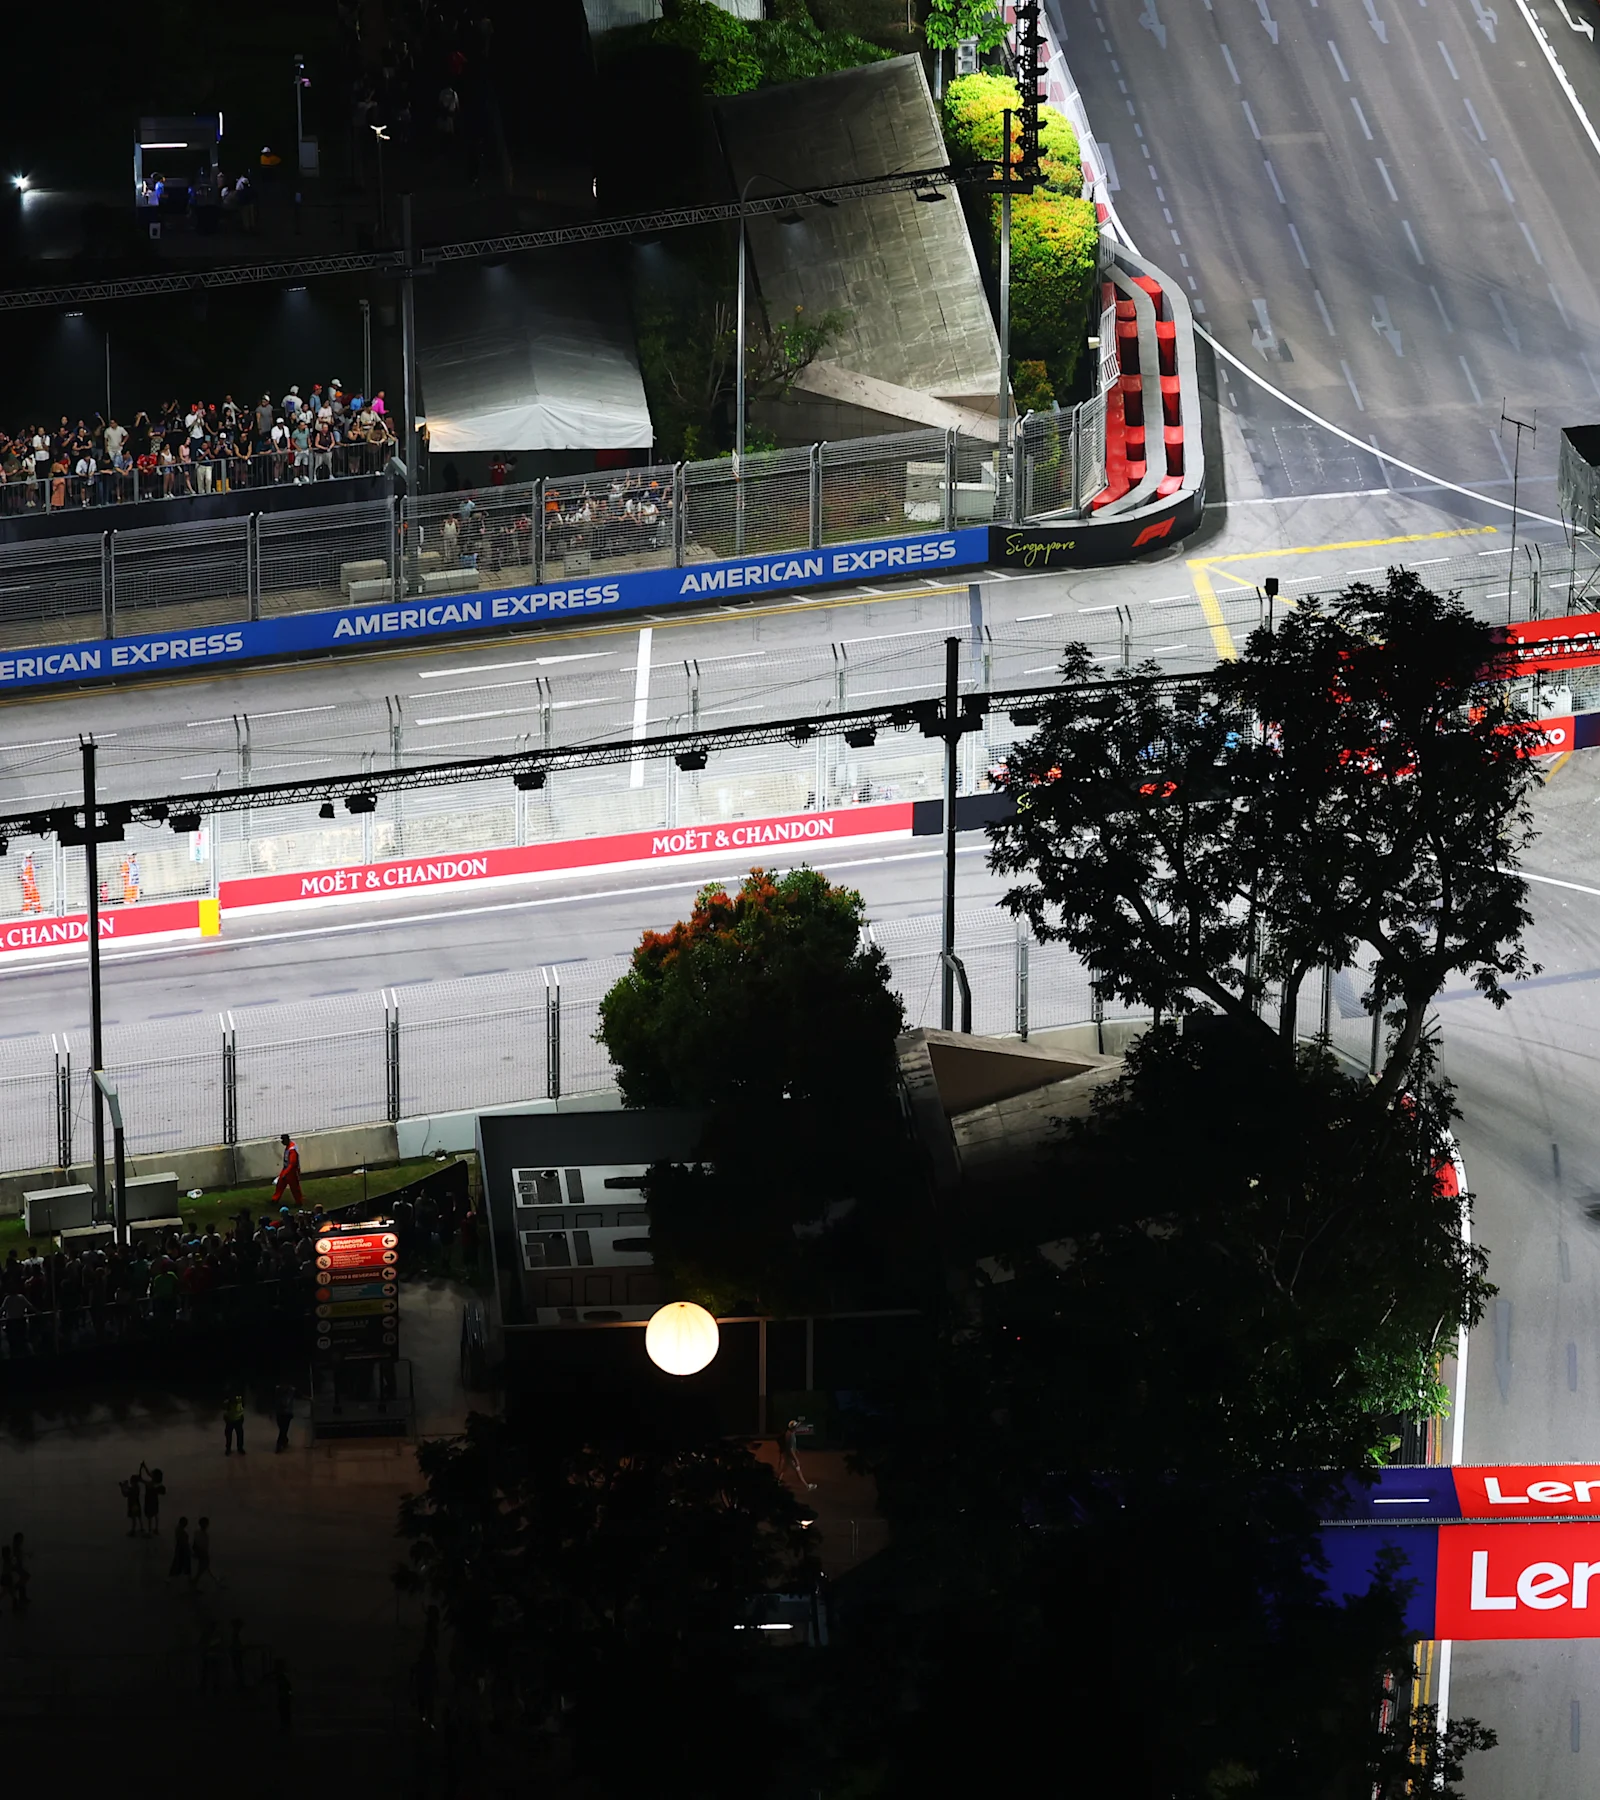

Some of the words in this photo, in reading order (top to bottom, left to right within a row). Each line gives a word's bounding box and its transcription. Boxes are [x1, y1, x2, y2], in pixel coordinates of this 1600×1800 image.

[680, 555, 823, 594] AMERICAN
[833, 540, 956, 571] EXPRESS
[1006, 533, 1077, 567] Singapore
[333, 601, 482, 639] AMERICAN
[492, 584, 620, 618] EXPRESS
[111, 632, 243, 667] EXPRESS
[652, 828, 711, 854] MOËT
[715, 830, 729, 848] &
[732, 818, 834, 844] CHANDON
[301, 870, 362, 895] MOËT
[365, 871, 380, 888] &
[383, 858, 487, 885] CHANDON
